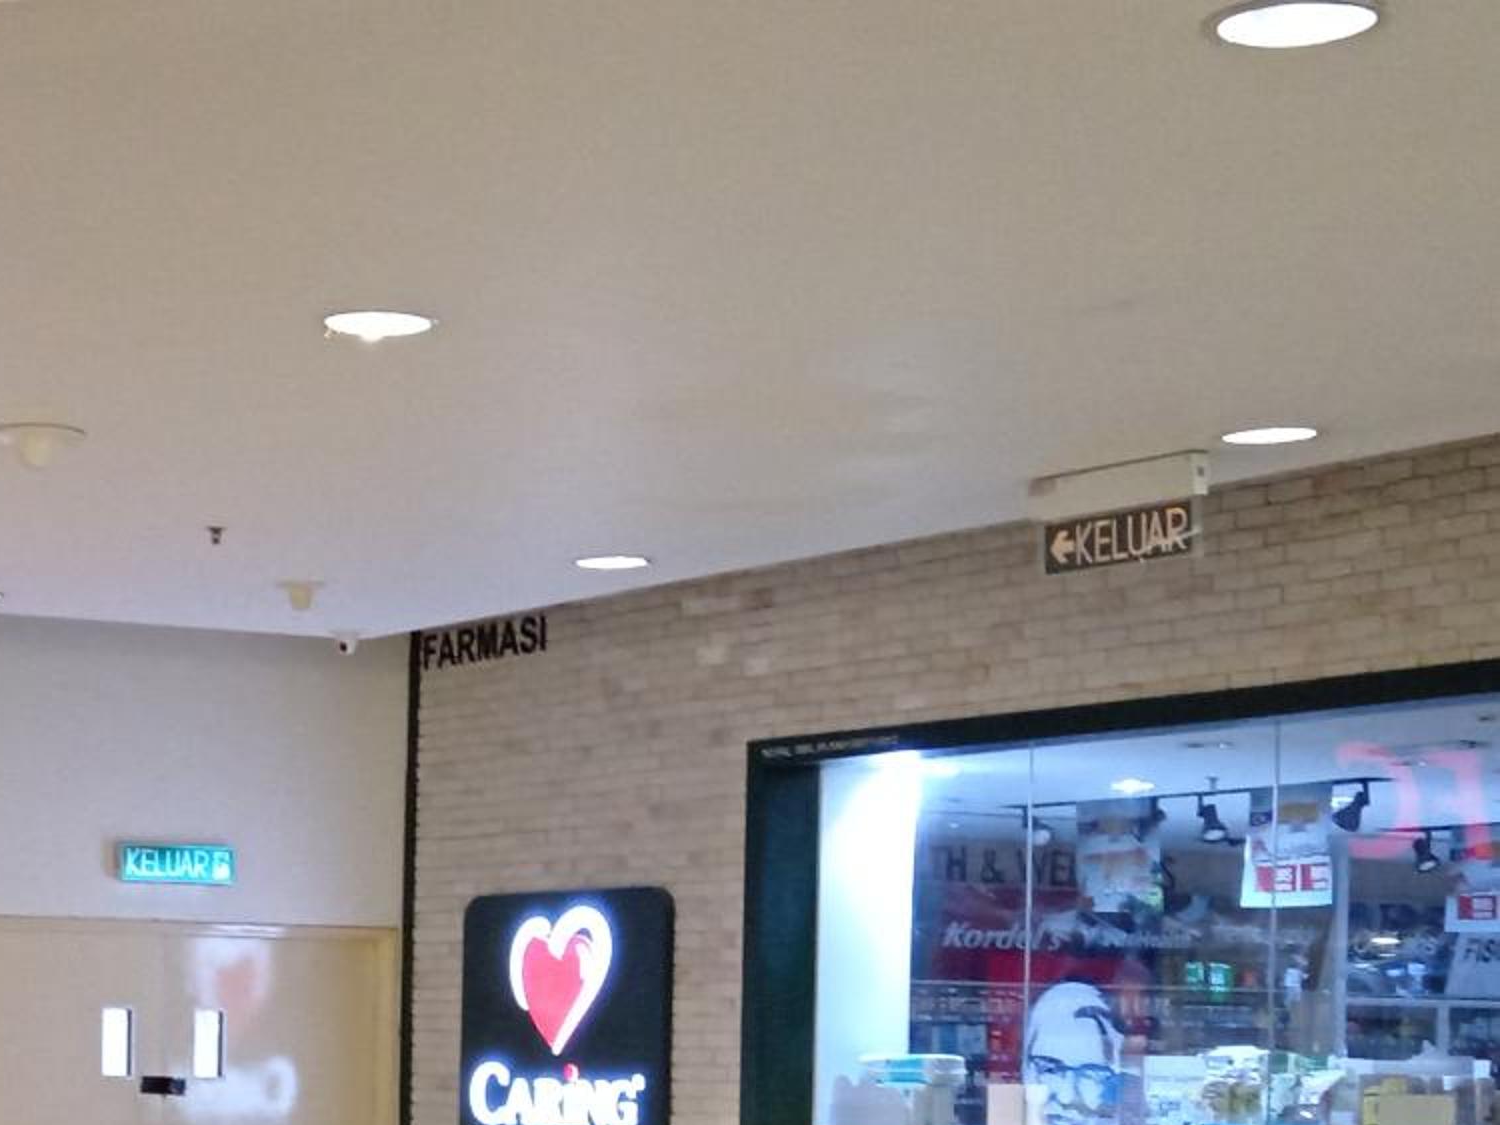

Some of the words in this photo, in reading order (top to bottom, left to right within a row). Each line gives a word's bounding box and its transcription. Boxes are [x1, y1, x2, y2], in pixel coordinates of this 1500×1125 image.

[1075, 507, 1188, 565] KELUAR
[422, 614, 548, 671] FARMASI
[125, 847, 210, 879] KELUAR
